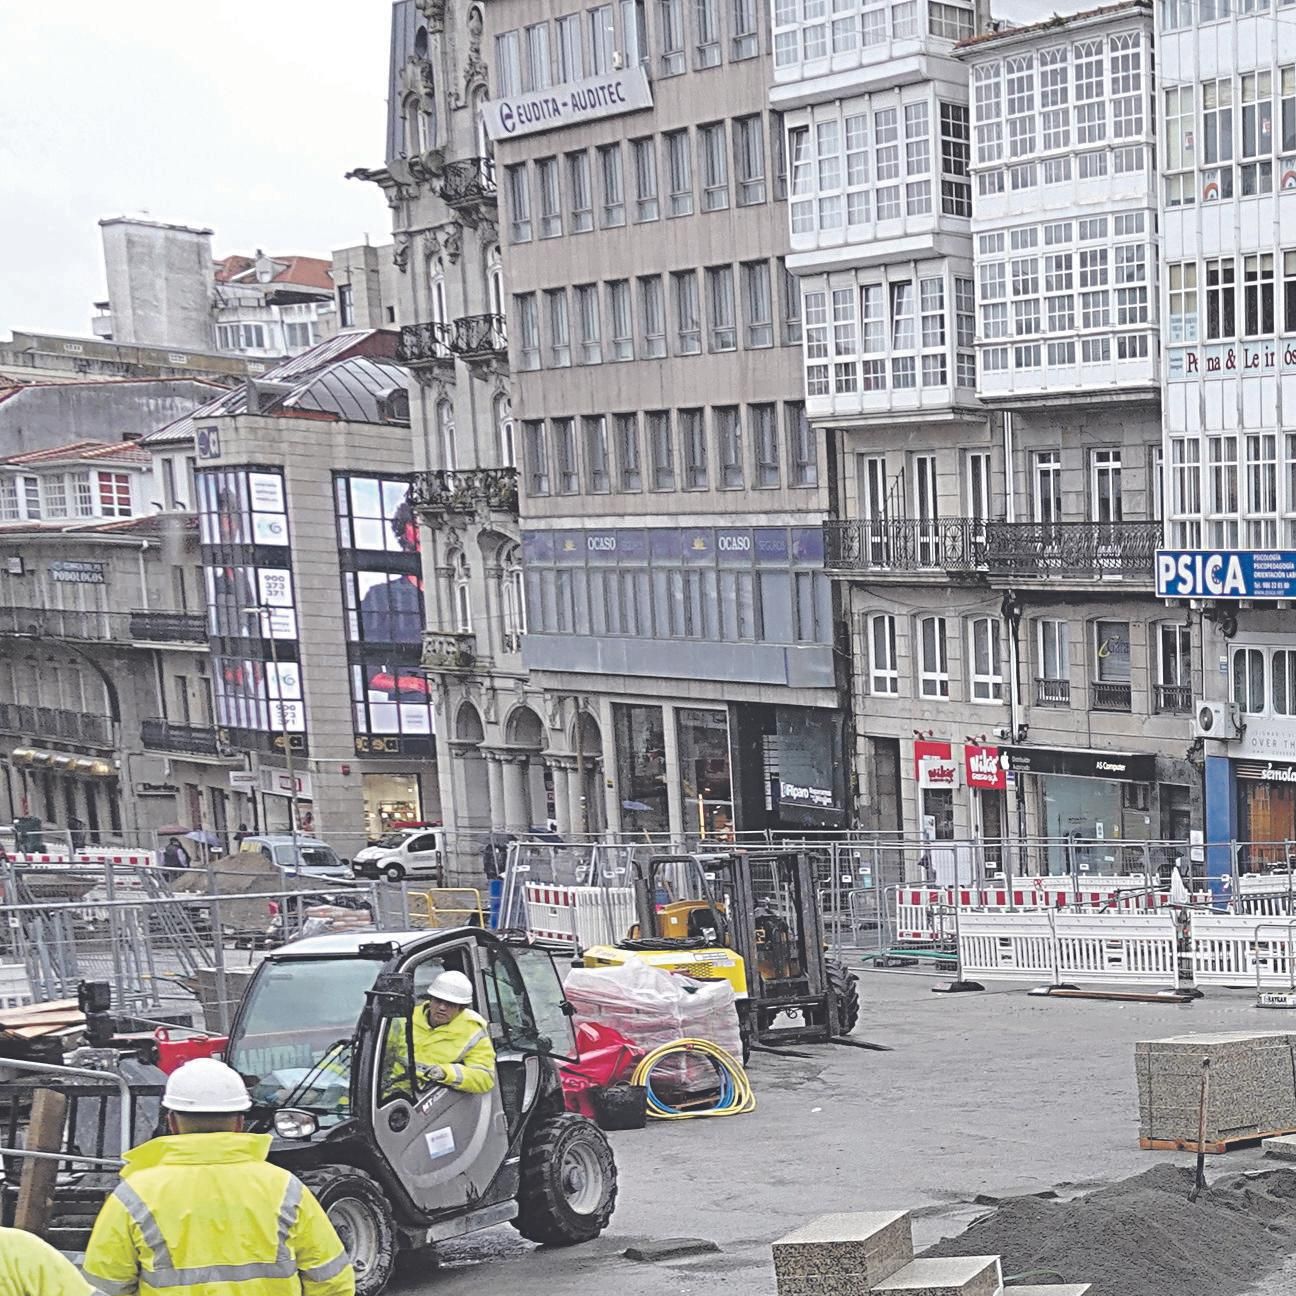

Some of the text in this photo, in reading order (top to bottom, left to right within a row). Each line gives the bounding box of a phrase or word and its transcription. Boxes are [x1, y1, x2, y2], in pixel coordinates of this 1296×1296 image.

[516, 98, 562, 125] EUDITA
[570, 82, 626, 113] AUDITEC
[1225, 349, 1236, 370] &
[587, 536, 616, 550] OCASO
[719, 536, 750, 550] OCASO
[1158, 554, 1247, 595] PSICA
[1253, 570, 1285, 578] ORIENTACIÓN
[1251, 738, 1277, 747] OVER
